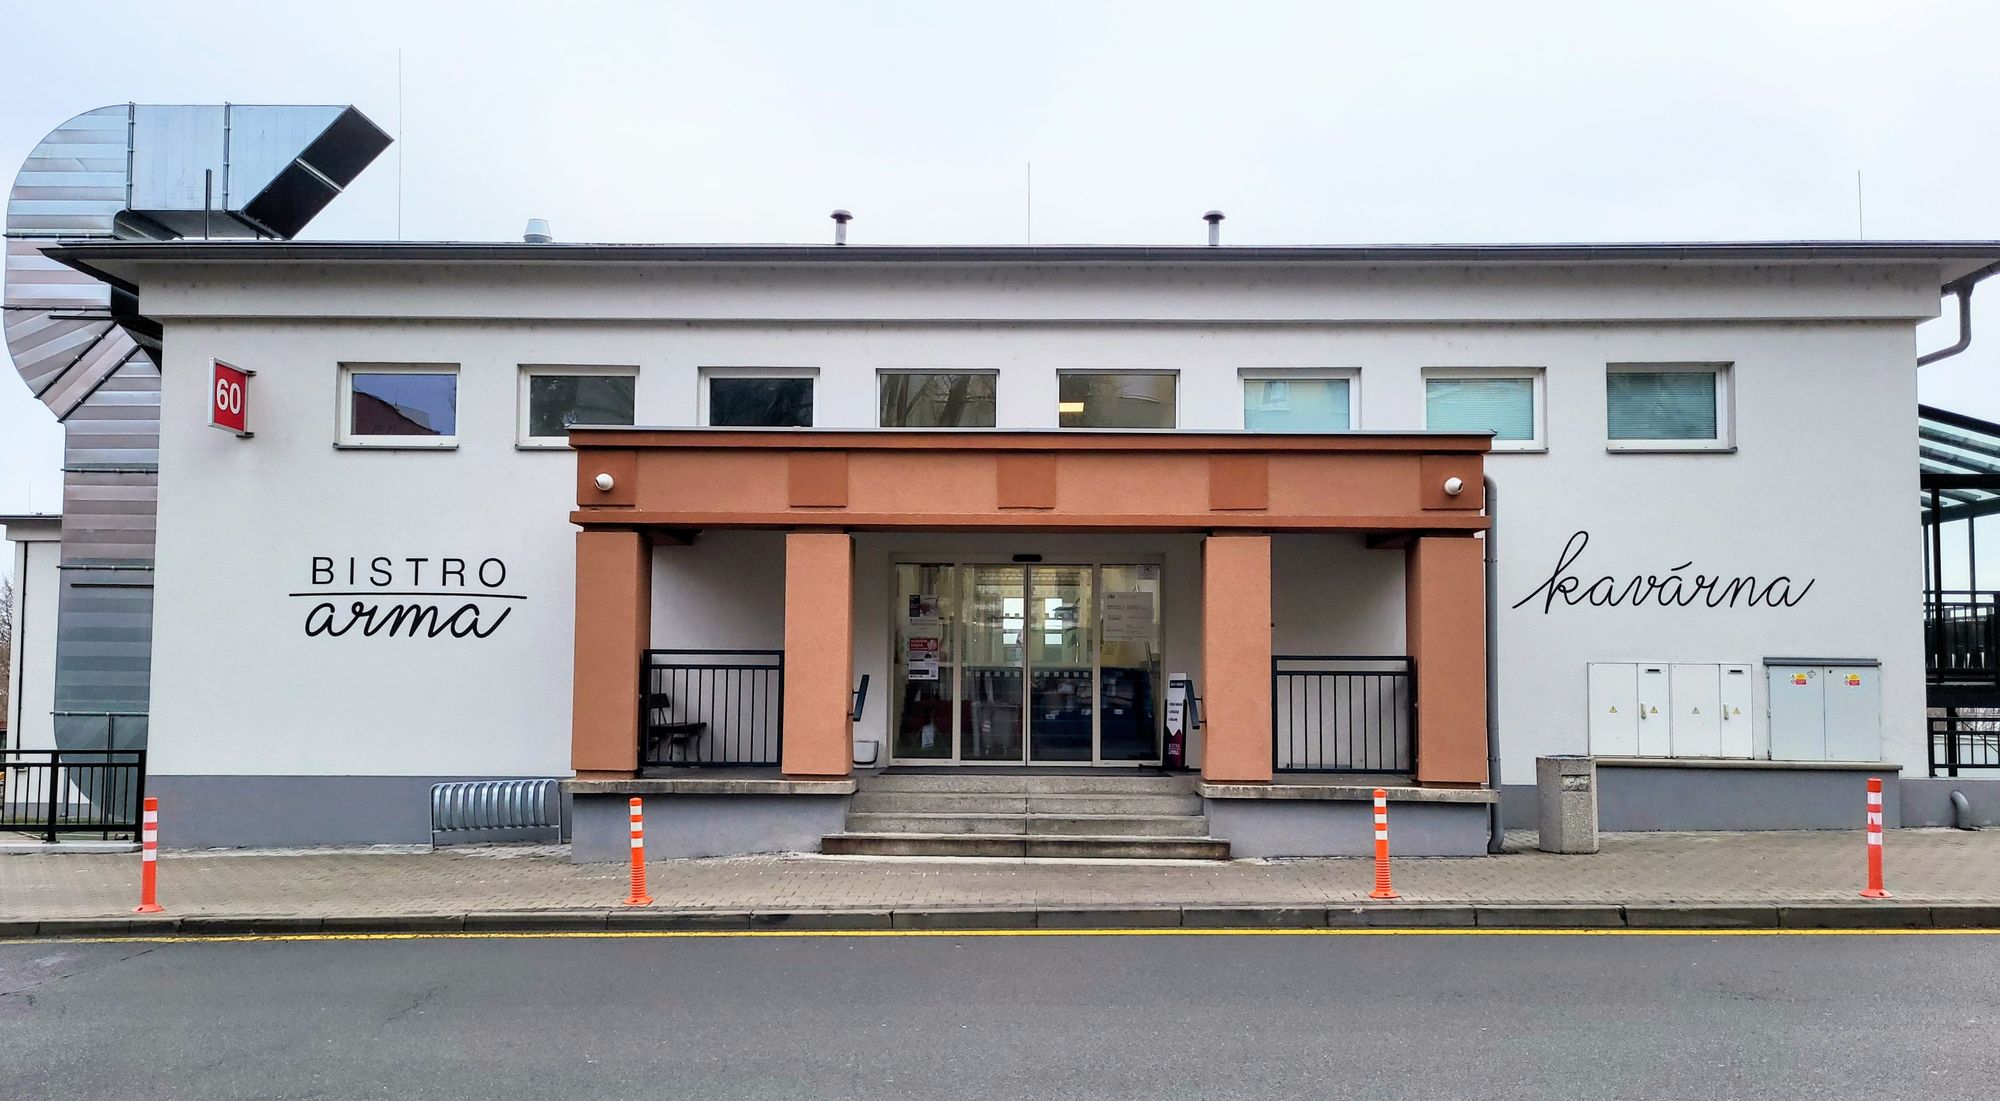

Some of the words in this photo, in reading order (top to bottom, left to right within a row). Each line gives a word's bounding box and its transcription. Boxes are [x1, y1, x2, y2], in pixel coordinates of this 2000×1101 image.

[216, 378, 241, 415] 60
[311, 556, 506, 588] BISTRO
[1511, 530, 1816, 615] kavárna
[304, 601, 512, 639] arma
